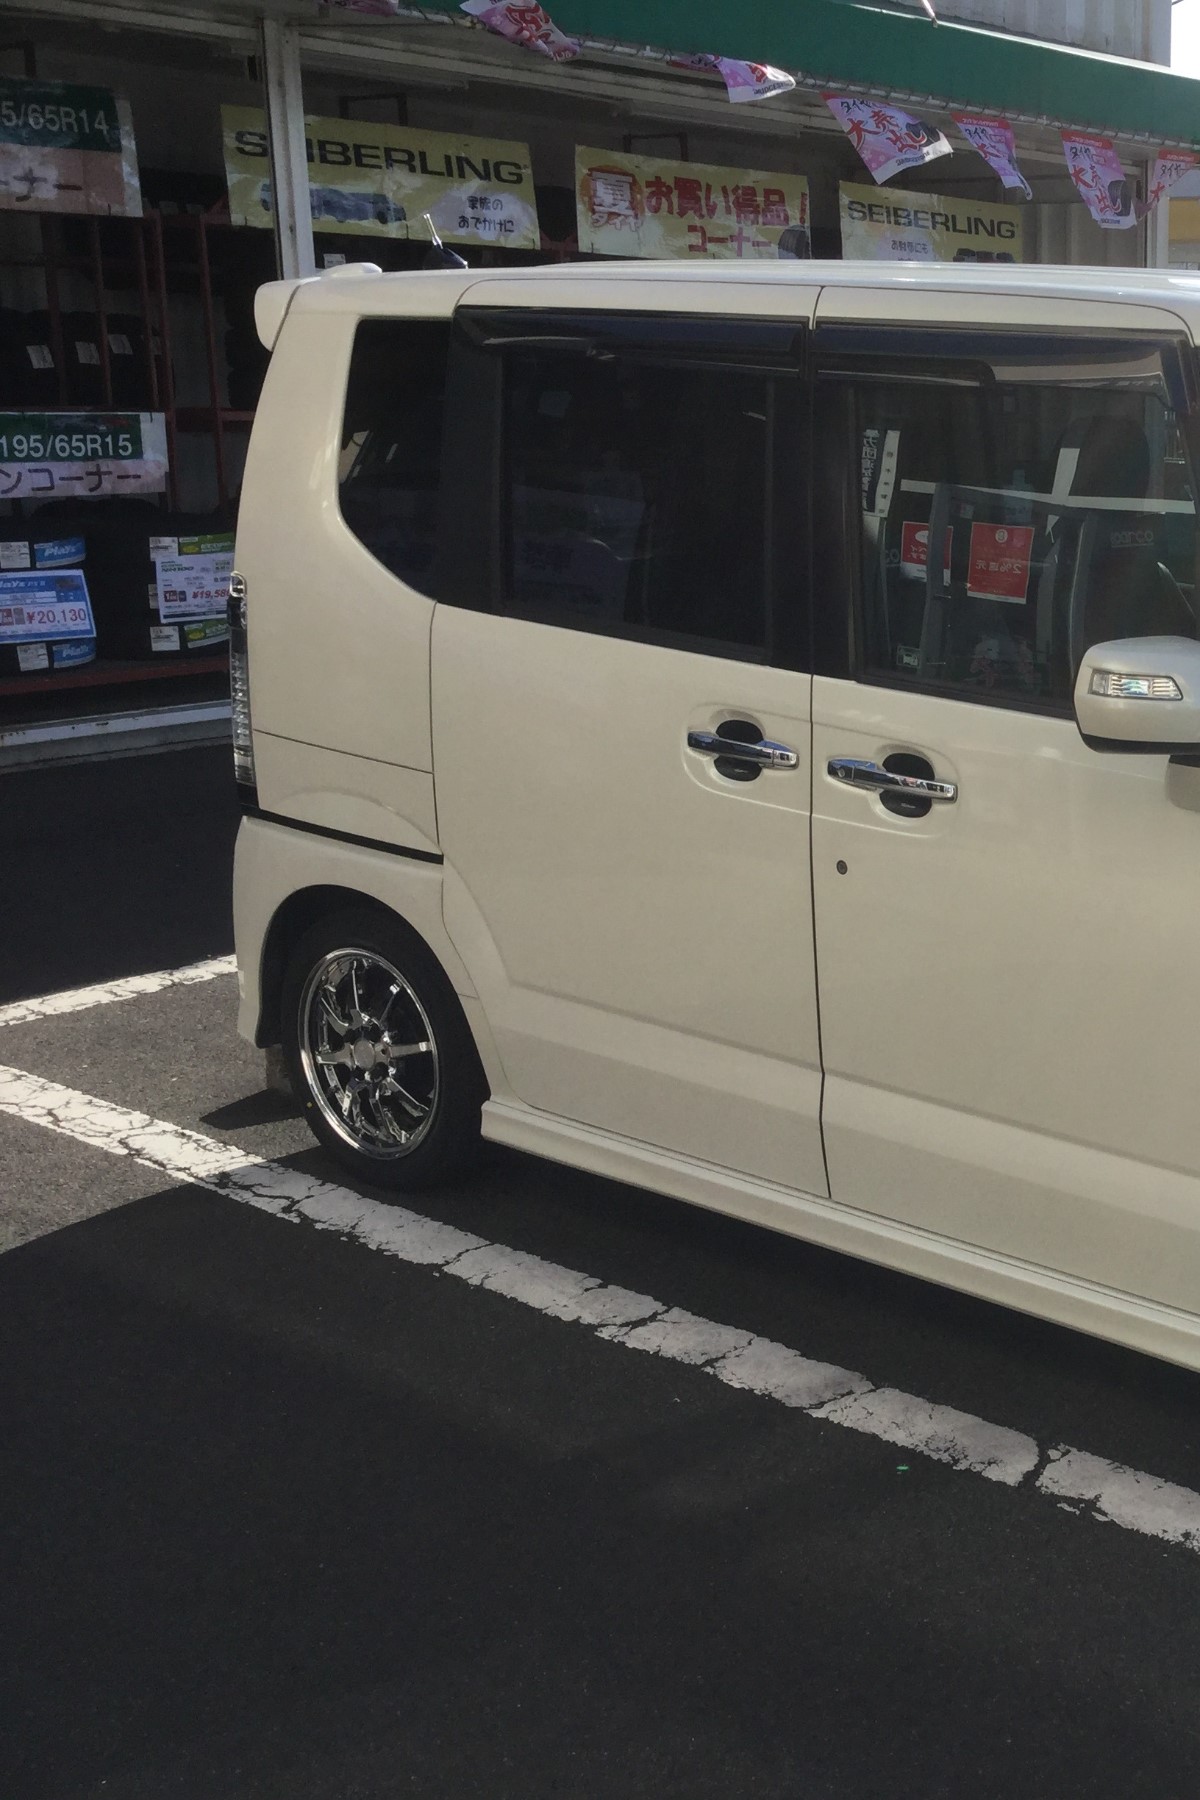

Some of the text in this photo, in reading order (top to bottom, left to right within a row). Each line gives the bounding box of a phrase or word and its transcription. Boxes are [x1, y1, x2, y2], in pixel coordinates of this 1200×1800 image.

[235, 130, 524, 185] SIBERLING
[457, 214, 515, 233] おでかけに
[847, 200, 1016, 240] SEIBERLING
[687, 224, 773, 258] コーナー
[0, 434, 133, 458] 195/65R15
[0, 464, 141, 493] ンコーナー
